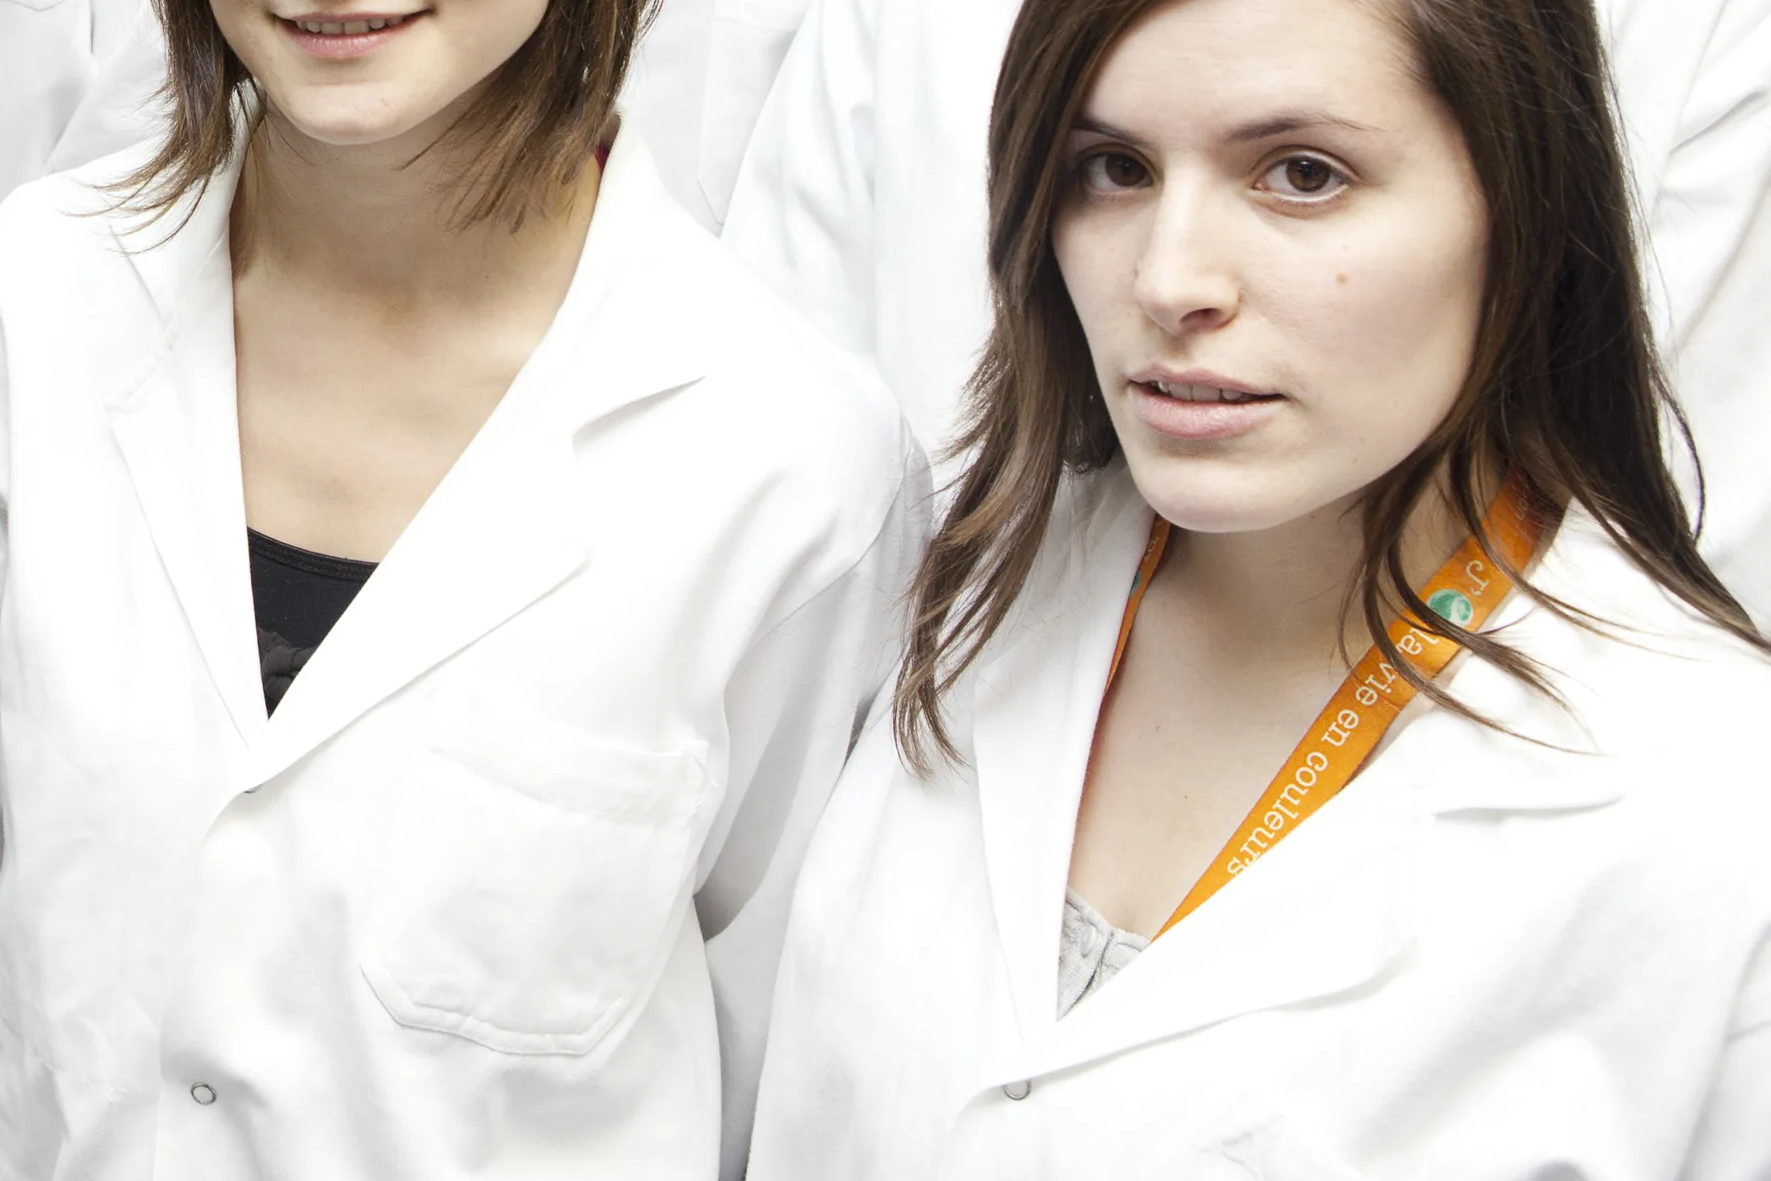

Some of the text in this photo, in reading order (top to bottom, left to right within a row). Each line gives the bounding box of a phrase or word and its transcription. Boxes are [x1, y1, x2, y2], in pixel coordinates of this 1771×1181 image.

[1395, 627, 1440, 656] la
[1355, 661, 1400, 706] vie
[1321, 708, 1360, 747] en
[1226, 751, 1329, 877] couleurs
